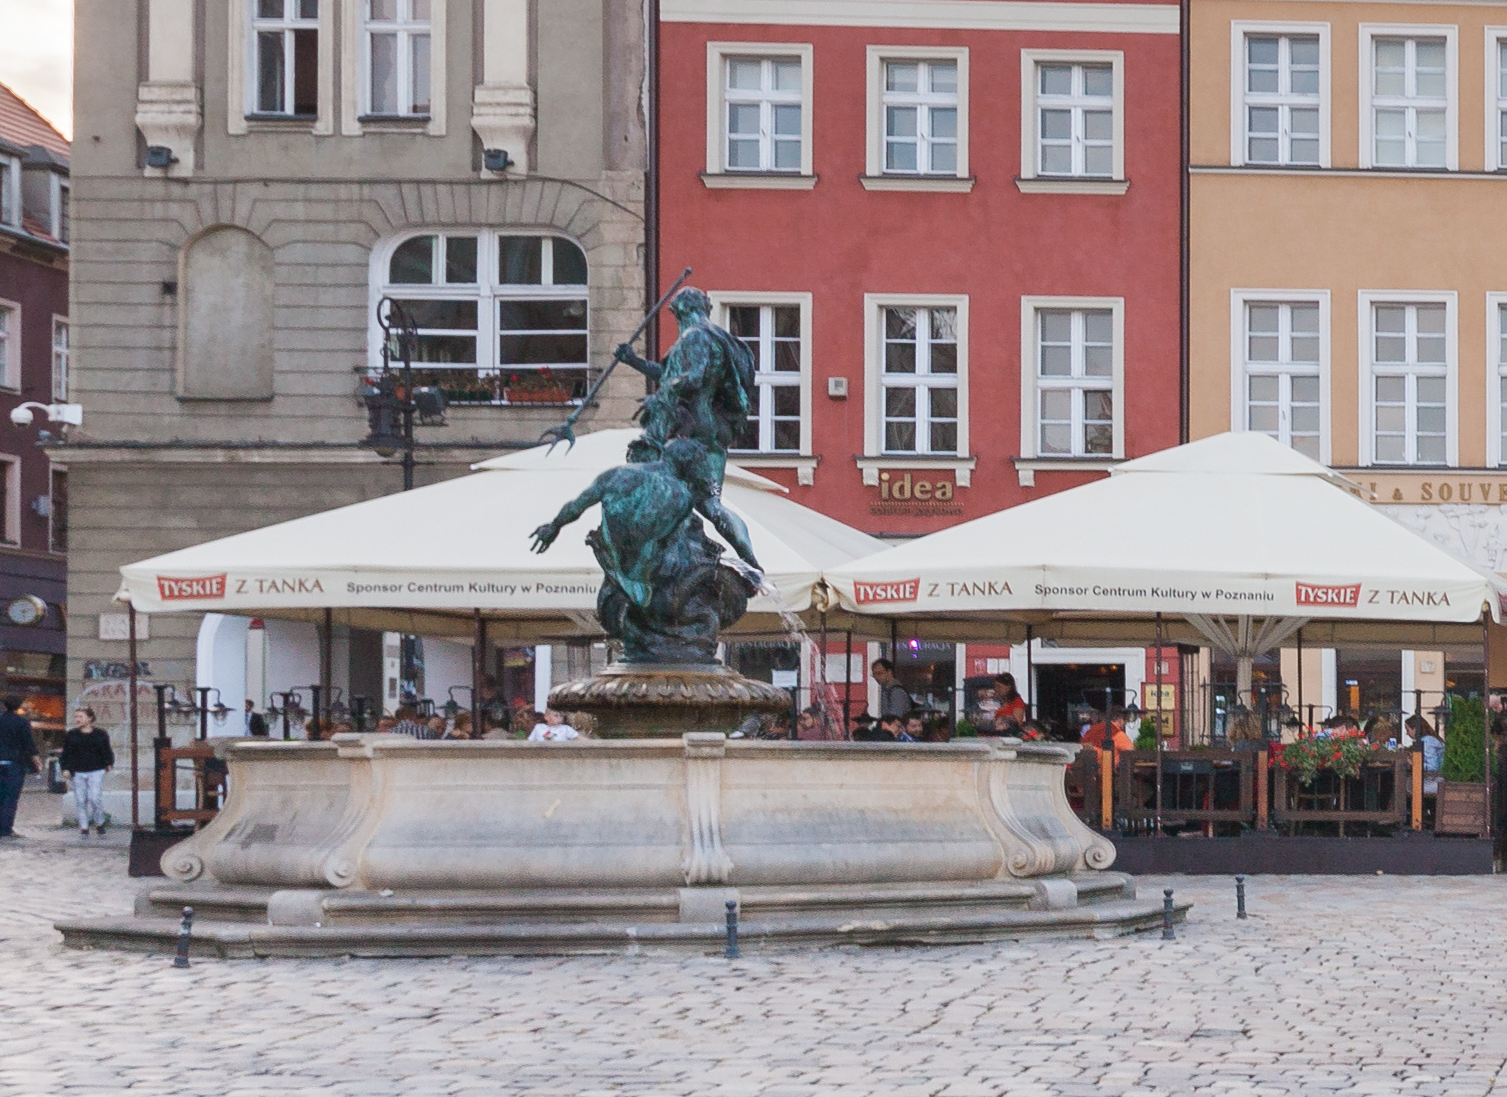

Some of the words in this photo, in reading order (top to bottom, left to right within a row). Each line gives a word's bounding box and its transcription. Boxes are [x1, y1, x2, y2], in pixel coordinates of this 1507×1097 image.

[880, 471, 953, 502] idea
[161, 578, 224, 599] TYSKIE
[234, 580, 248, 595] Z
[254, 578, 325, 595] TANKA
[347, 582, 403, 595] Sponsor
[406, 582, 465, 594] Centrum
[468, 582, 517, 596] Kultury
[521, 584, 532, 594] w
[536, 582, 598, 595] Poznaniu
[857, 581, 917, 601] TYSKIE
[927, 583, 940, 597] Z
[945, 580, 1014, 597] TANKA
[1034, 584, 1089, 598] Sponsor
[1093, 585, 1147, 598] Centrum
[1151, 587, 1198, 601] Kultury
[1201, 589, 1212, 600] w
[1215, 589, 1275, 602] Poznaniu
[1297, 584, 1357, 604] TYSKIE
[1367, 589, 1380, 604] Z
[1386, 590, 1451, 607] TANKA
